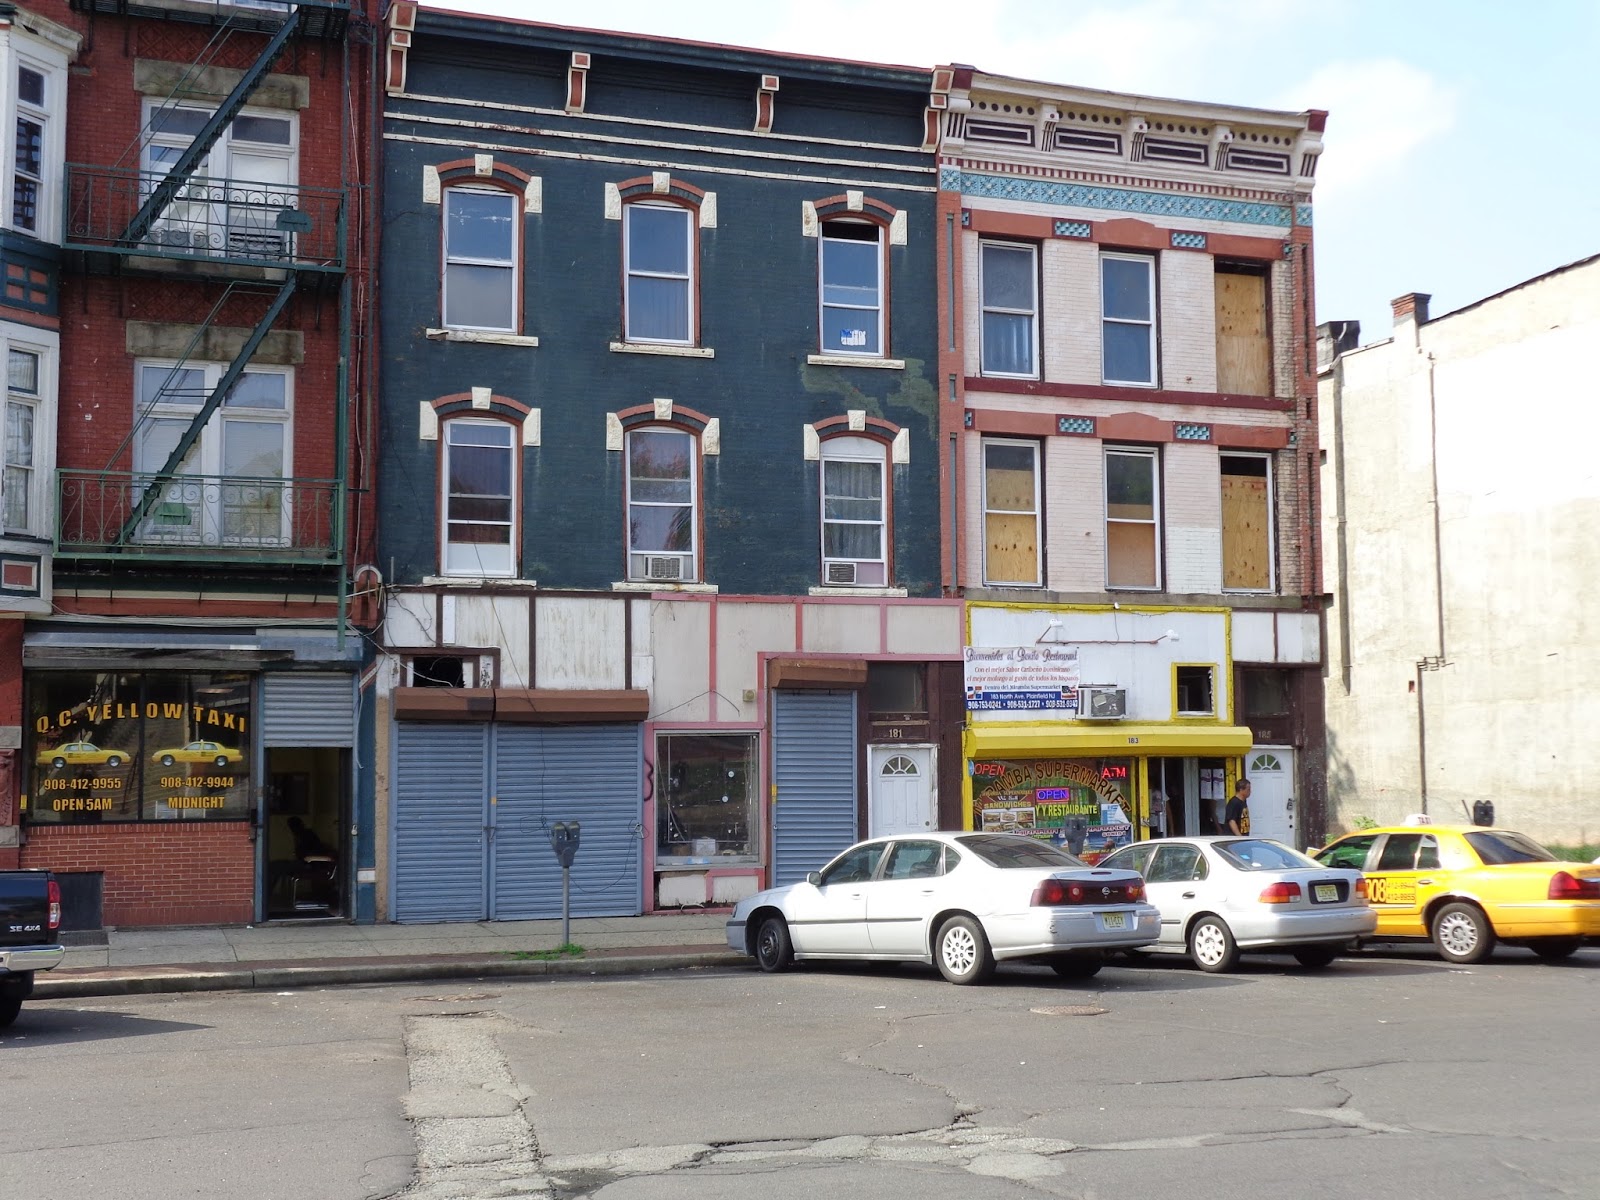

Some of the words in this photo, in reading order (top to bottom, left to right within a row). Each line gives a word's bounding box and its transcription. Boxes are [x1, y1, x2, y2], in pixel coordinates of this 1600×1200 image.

[87, 702, 182, 721] YELLOW
[193, 706, 246, 732] TAXI
[888, 728, 903, 738] 181
[974, 763, 1006, 776] OPEN
[1102, 766, 1126, 778] ATM
[44, 778, 122, 790] 908-412-9955
[160, 776, 235, 788] 908-412-9944
[1035, 762, 1132, 812] SUPERMARKET
[1037, 788, 1068, 800] OPEN
[53, 799, 83, 811] OPEN
[86, 798, 112, 811] 5AM
[168, 796, 225, 809] MIDNIGHT
[983, 801, 1032, 809] SANDWICHES
[1048, 804, 1098, 817] RESTAURANTE
